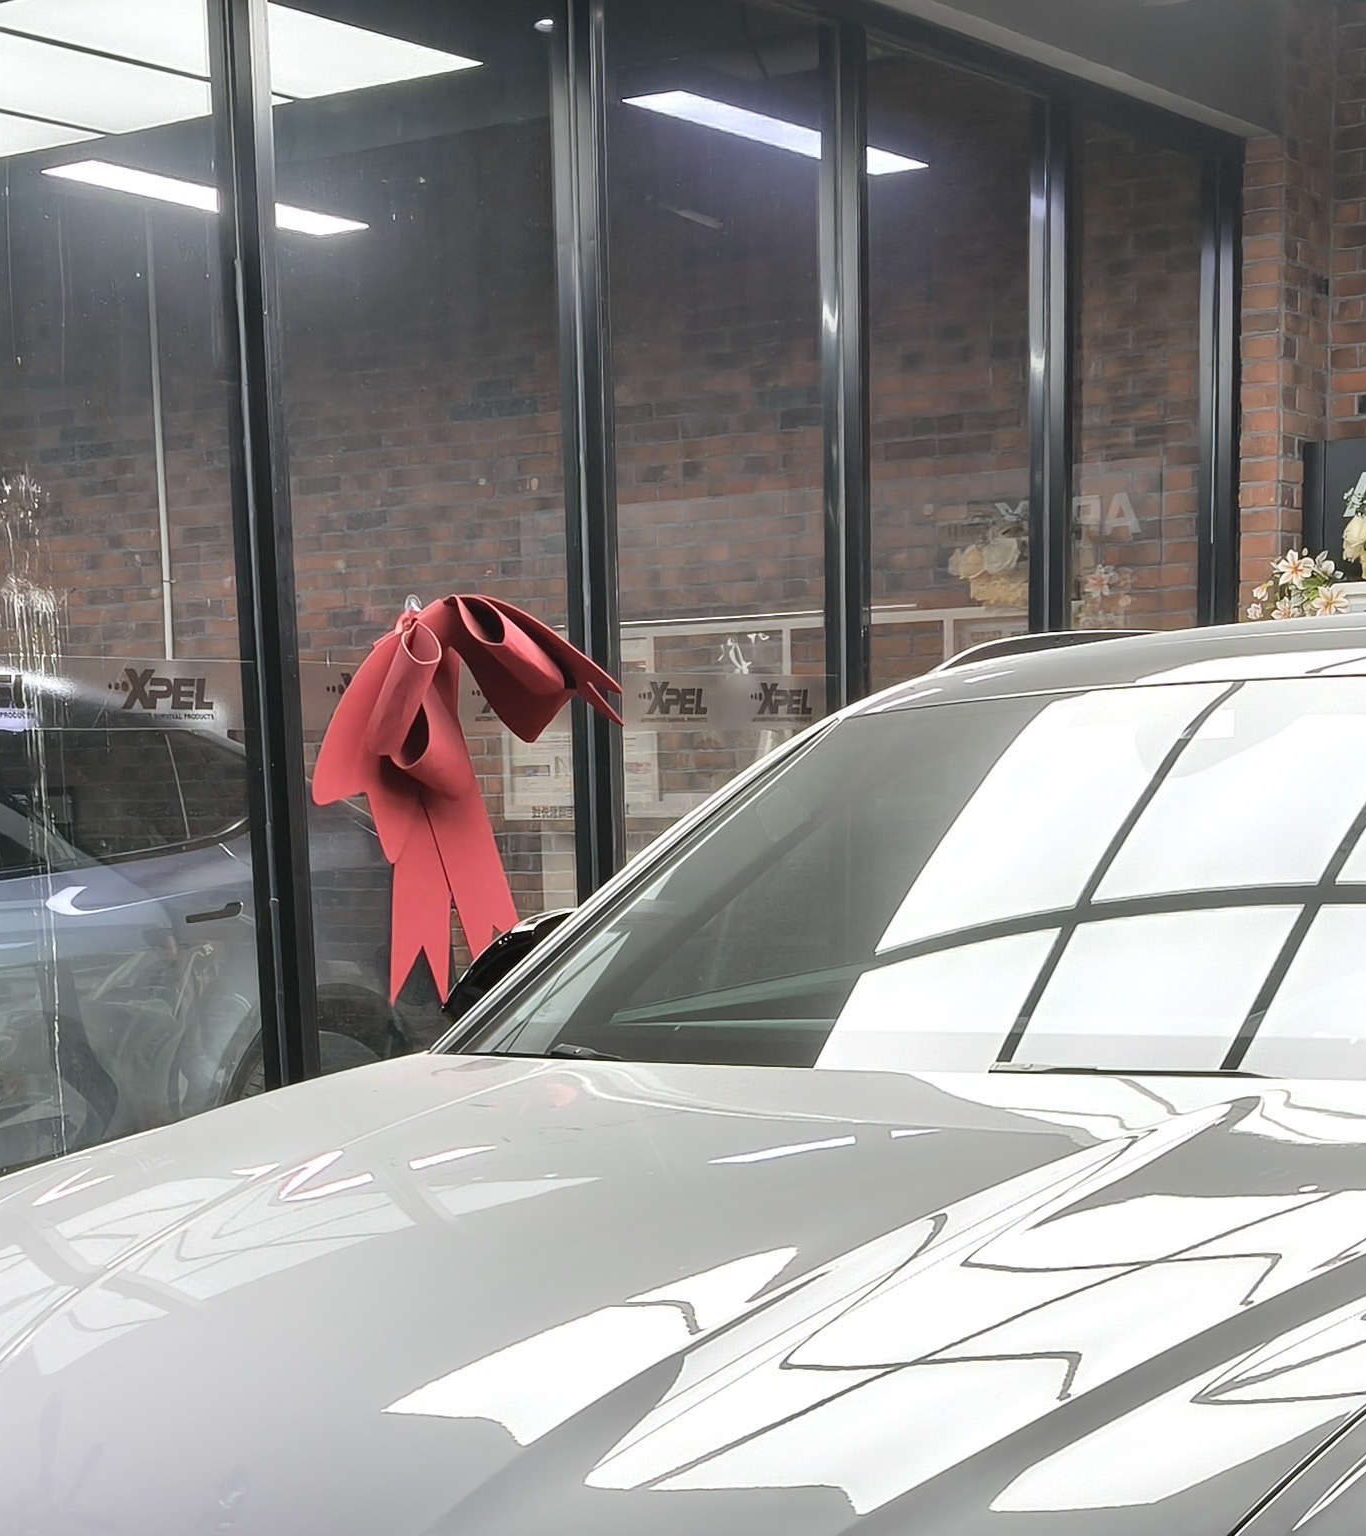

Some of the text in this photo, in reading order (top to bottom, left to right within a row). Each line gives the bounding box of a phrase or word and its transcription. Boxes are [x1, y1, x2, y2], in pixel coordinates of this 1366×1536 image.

[122, 668, 214, 710] XPEL
[647, 682, 708, 715] XPEL
[758, 683, 813, 715] XPEL
